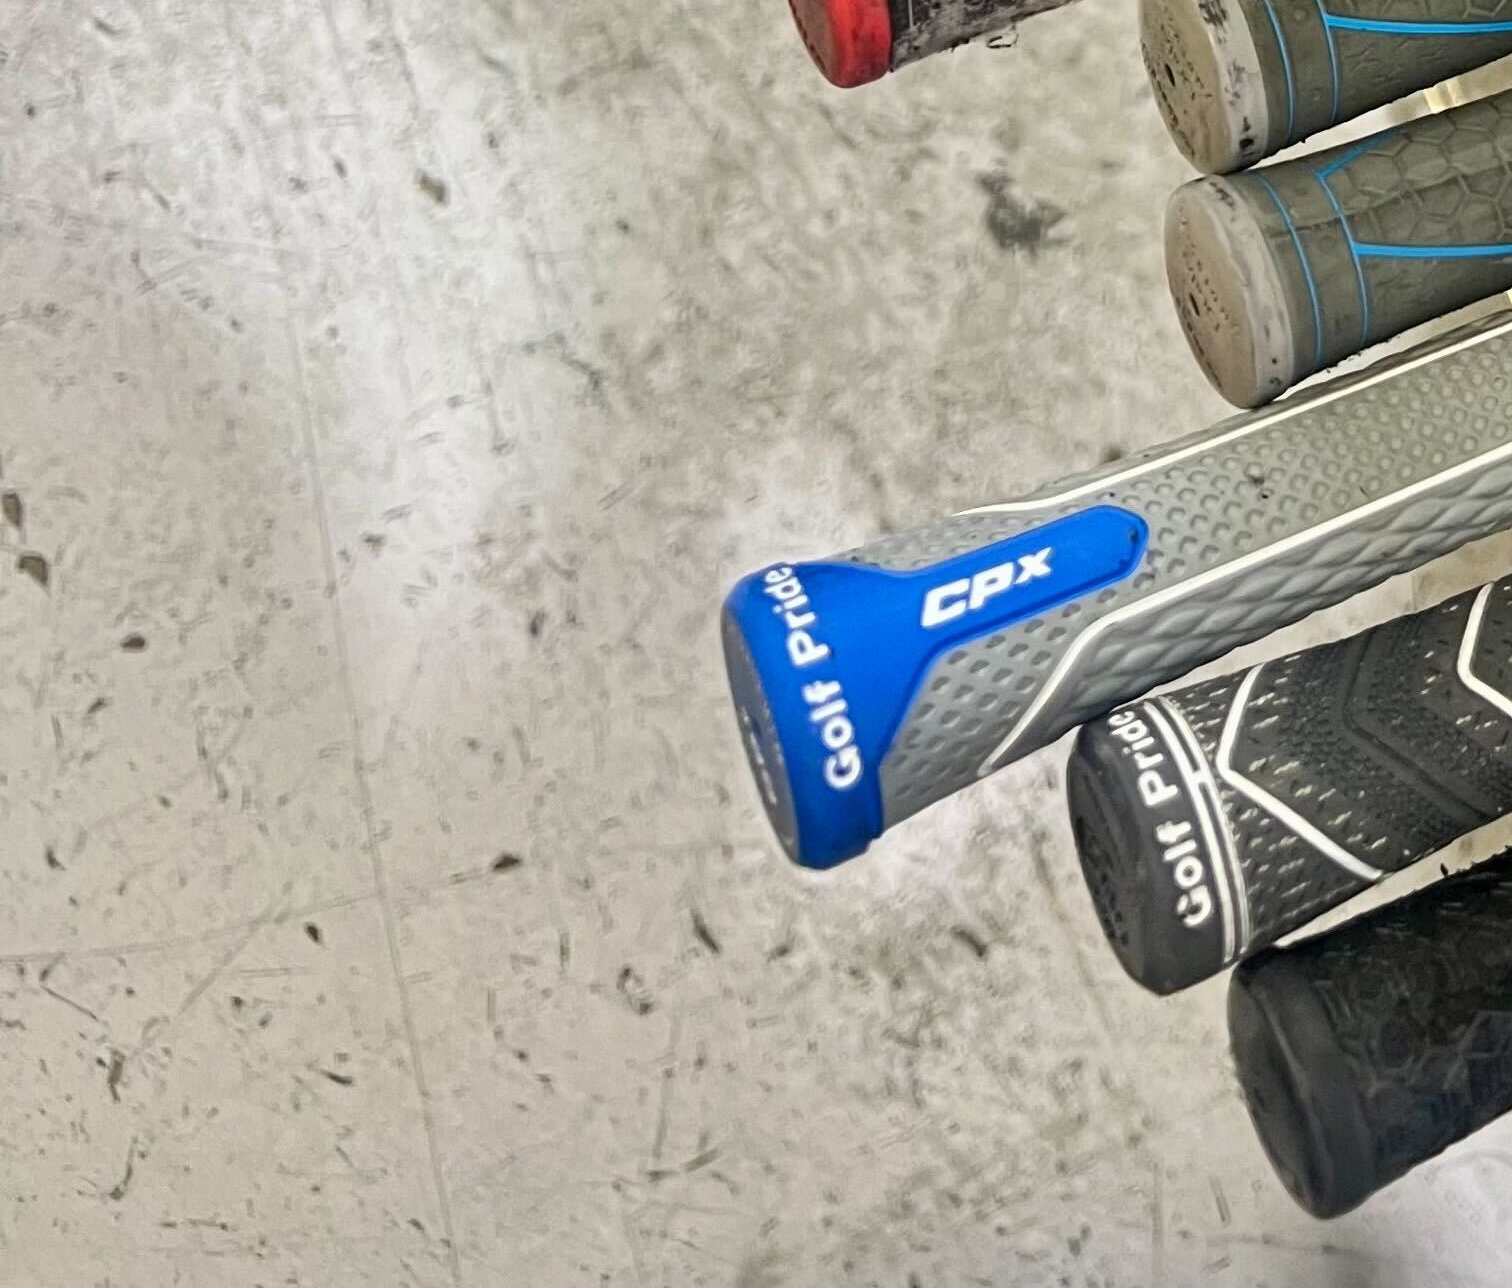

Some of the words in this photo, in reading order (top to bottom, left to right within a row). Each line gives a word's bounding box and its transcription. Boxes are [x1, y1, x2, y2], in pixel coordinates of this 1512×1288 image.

[764, 563, 831, 667] Pride
[920, 546, 1052, 628] CPX
[803, 679, 863, 789] Golf
[1107, 709, 1179, 808] Pride
[1155, 820, 1212, 928] Golf
